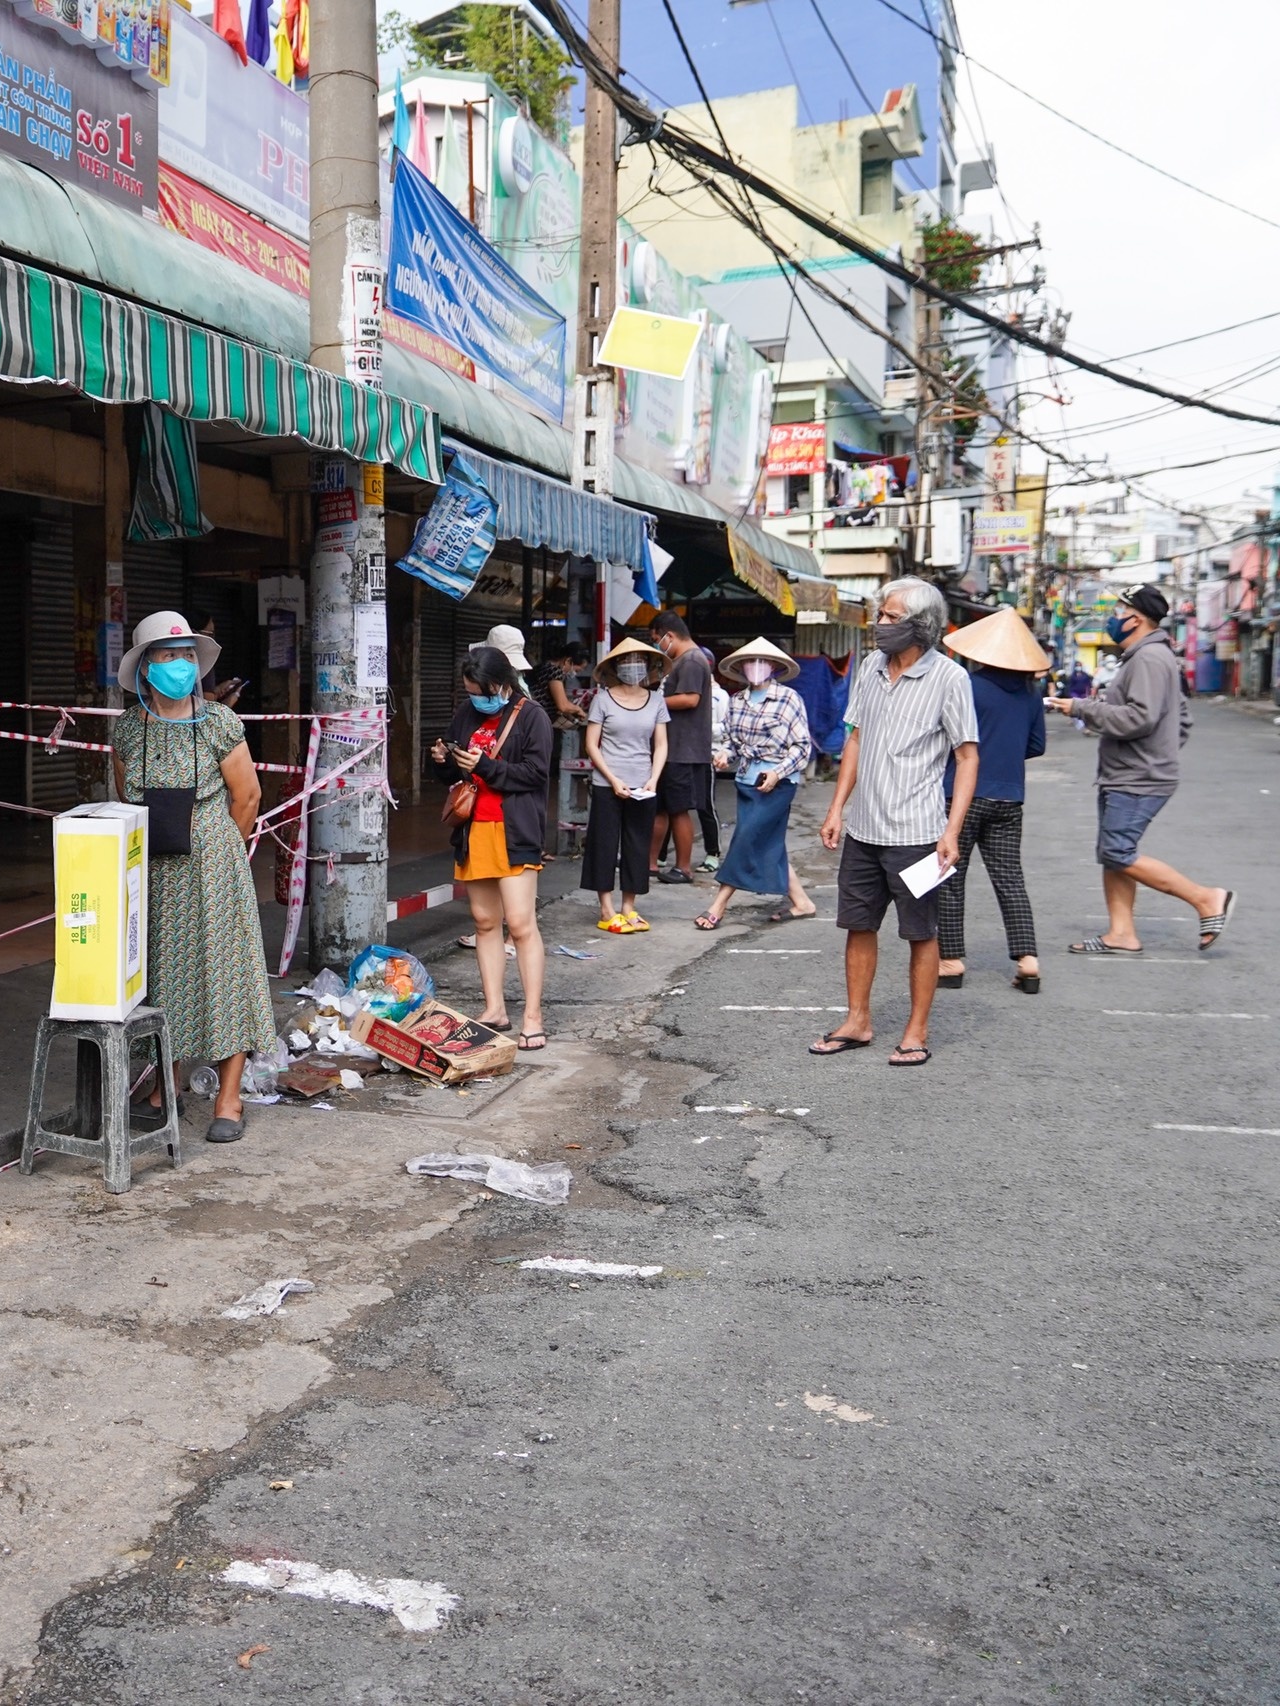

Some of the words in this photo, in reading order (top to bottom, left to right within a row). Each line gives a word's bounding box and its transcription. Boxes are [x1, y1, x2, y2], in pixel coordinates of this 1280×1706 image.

[11, 87, 34, 113] CÔN
[36, 104, 72, 133] TRÙNG
[22, 67, 72, 112] PHẨM
[26, 117, 72, 161] CHẠY
[77, 109, 111, 155] Số
[77, 151, 110, 181] VIỆT
[113, 168, 144, 198] NAM
[257, 128, 310, 205] PH
[190, 198, 220, 238] NGÀY
[71, 931, 80, 944] 18
